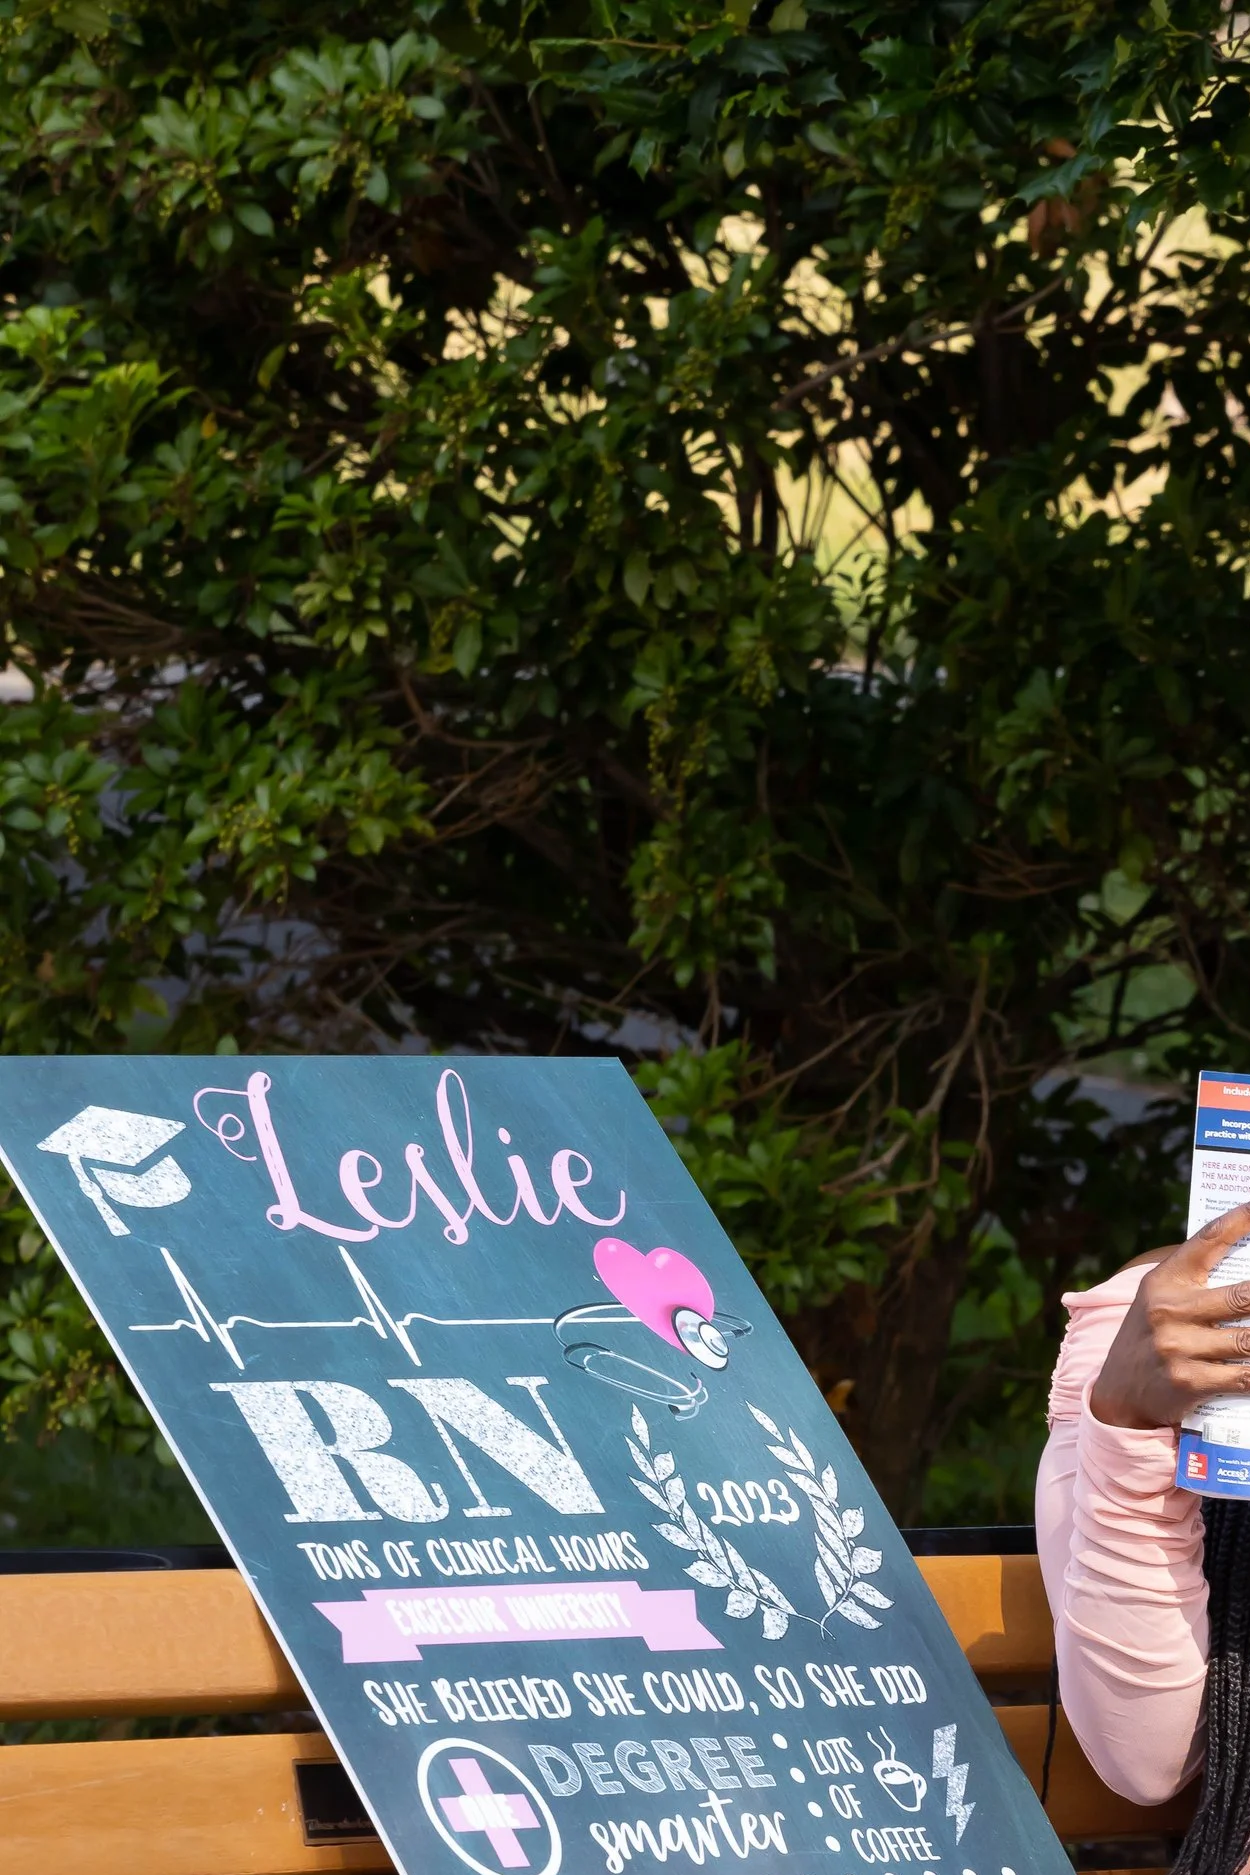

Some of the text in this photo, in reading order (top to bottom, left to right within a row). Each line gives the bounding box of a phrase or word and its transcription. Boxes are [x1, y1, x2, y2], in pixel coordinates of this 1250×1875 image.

[194, 1069, 626, 1245] Leslie
[1204, 1129, 1237, 1140] practice
[1201, 1171, 1215, 1180] THE
[1216, 1172, 1239, 1182] MANY
[1202, 1161, 1221, 1170] HERE
[1222, 1163, 1237, 1171] ARE
[208, 1375, 606, 1524] RN
[696, 1479, 801, 1527] 2023
[297, 1531, 650, 1581] TONS OF CLINICAL HOURS
[385, 1591, 632, 1637] EXCELSIOR UNIVERSITY
[363, 1680, 438, 1727] SHE
[431, 1675, 572, 1723] BELIEVED
[573, 1671, 646, 1717] SHE
[753, 1664, 805, 1710] SO
[805, 1663, 876, 1708] SHE
[870, 1664, 928, 1705] DID
[528, 1736, 777, 1797] DEGREE
[802, 1736, 865, 1776] LOTS
[458, 1793, 521, 1830] ONE
[828, 1783, 864, 1820] OF
[589, 1788, 789, 1875] smarter
[851, 1826, 941, 1864] COFFEE
